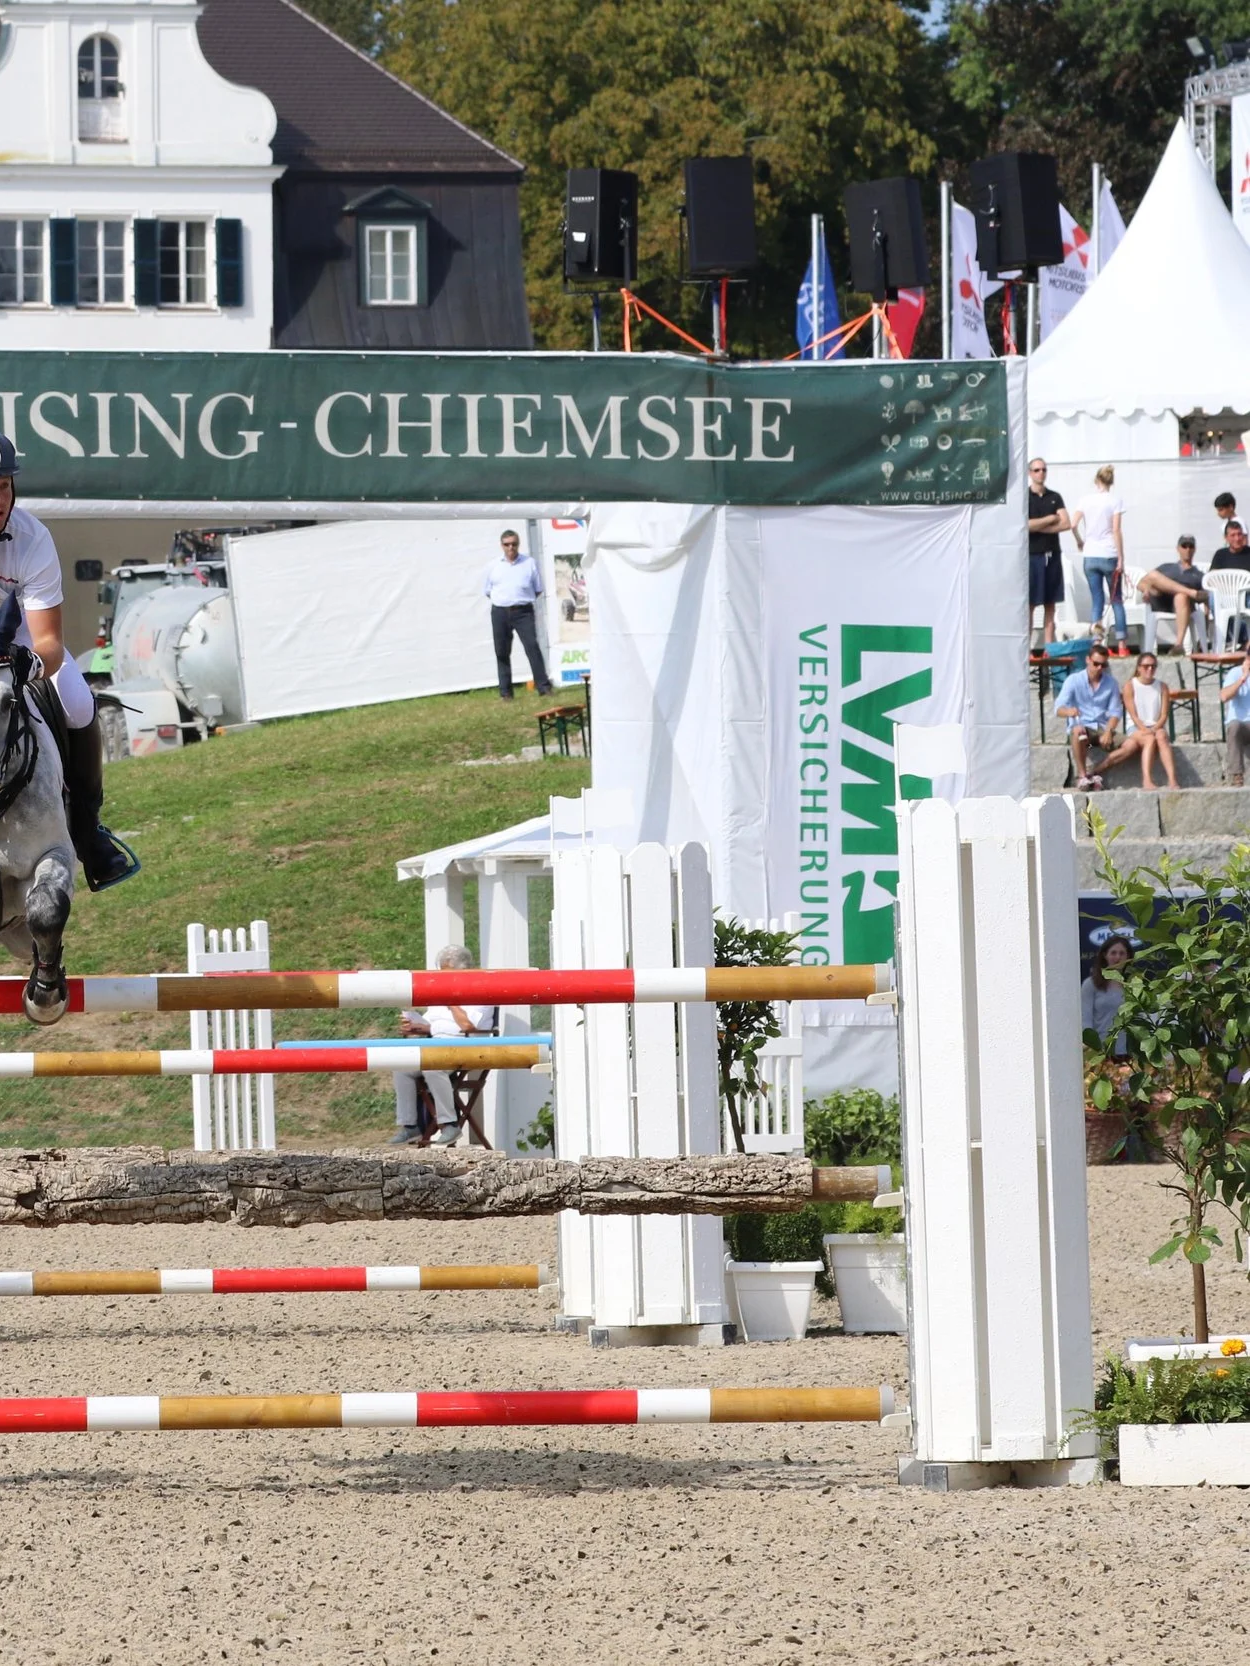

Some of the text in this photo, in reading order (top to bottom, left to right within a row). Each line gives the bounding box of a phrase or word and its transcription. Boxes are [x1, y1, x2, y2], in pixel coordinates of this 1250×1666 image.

[313, 391, 795, 462] CHIEMSEE
[798, 624, 830, 966] VERSICHERUNG
[841, 624, 933, 856] LVM
